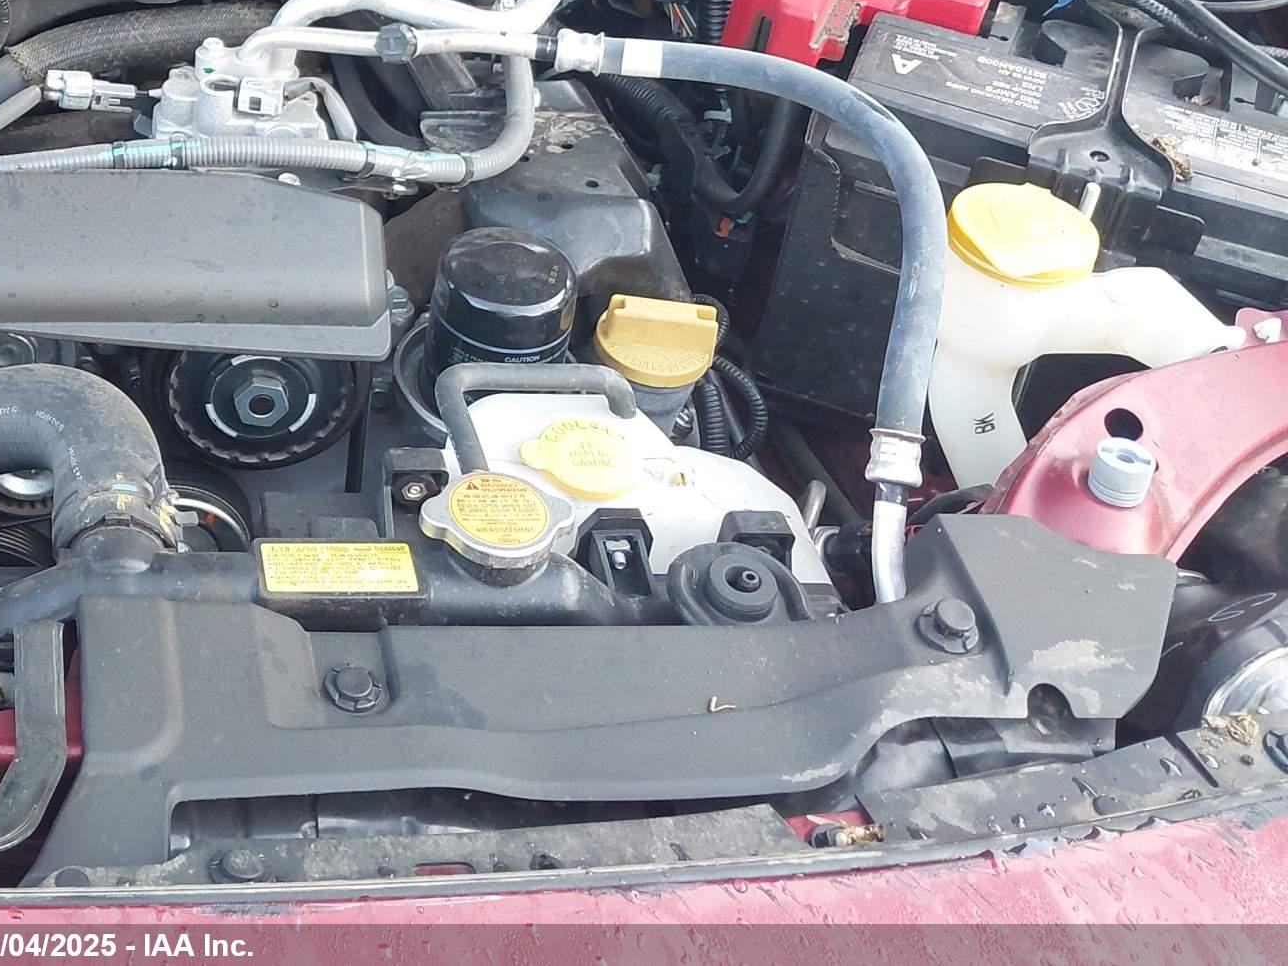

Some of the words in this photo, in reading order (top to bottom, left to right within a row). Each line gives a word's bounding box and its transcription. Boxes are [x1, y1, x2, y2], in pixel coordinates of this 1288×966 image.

[945, 81, 970, 91] AMPS
[984, 85, 1020, 99] AMPS
[1014, 99, 1039, 110] COLD
[504, 354, 541, 363] CAUTION
